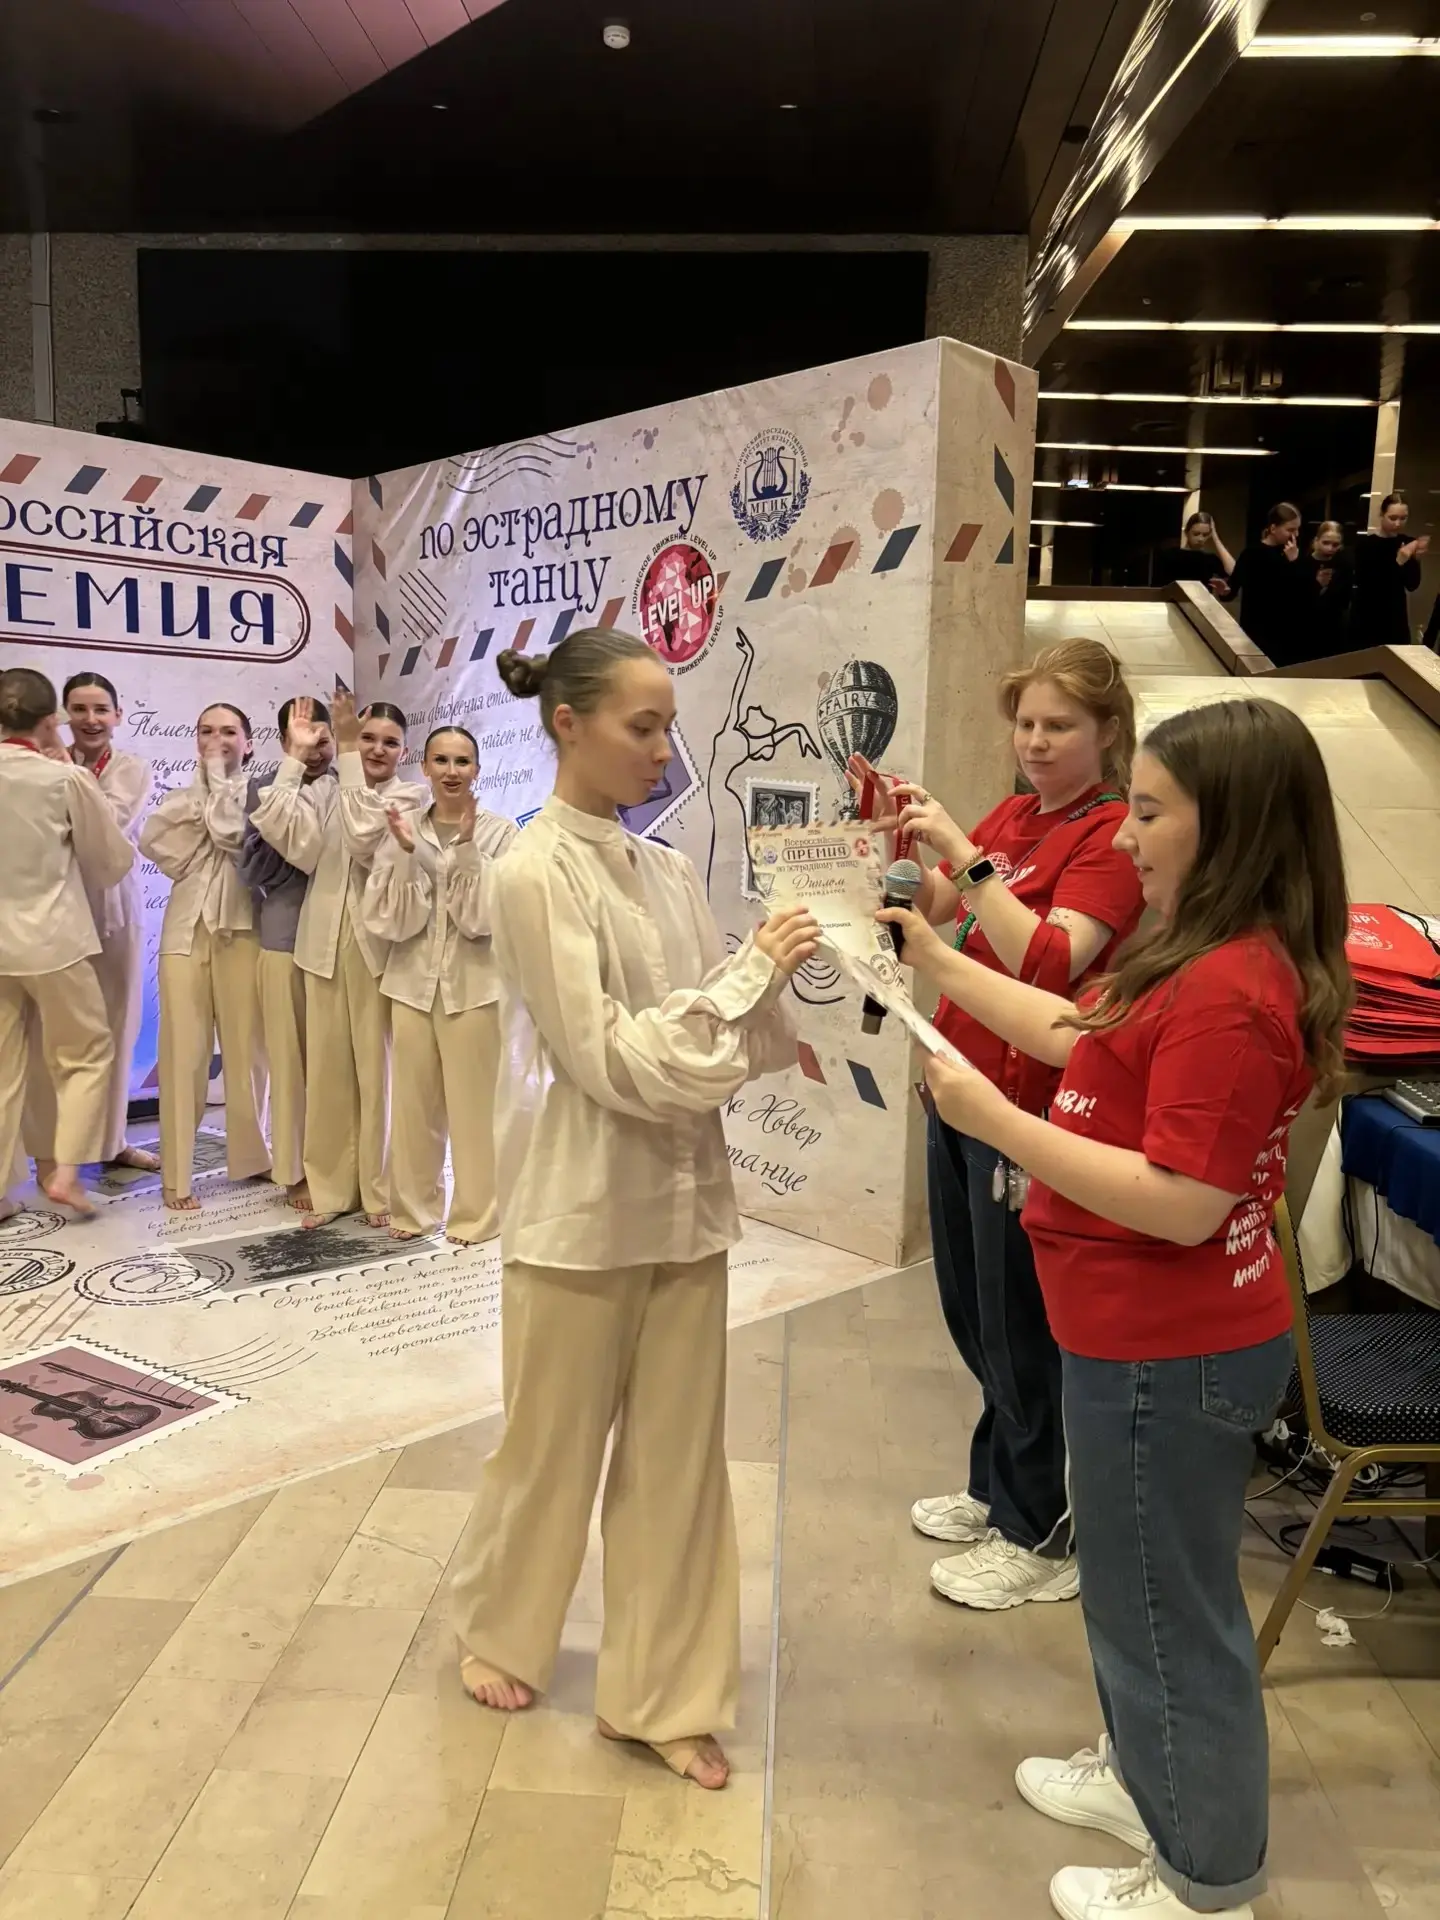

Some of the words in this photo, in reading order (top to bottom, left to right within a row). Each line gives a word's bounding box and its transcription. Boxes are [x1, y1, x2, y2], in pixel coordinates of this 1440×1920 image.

[743, 436, 770, 465] ИНСТИТУТ
[771, 436, 799, 456] КУЛЬТУРЫ
[419, 521, 455, 560] по
[463, 474, 709, 559] эстрадному
[750, 498, 788, 514] МГИК
[488, 556, 612, 613] танцу
[631, 554, 652, 616] ТВОРЧЕСКОЕ
[651, 533, 688, 557] ДВИЖЕНИЕ
[690, 533, 709, 554] LEVEL
[708, 549, 717, 562] UP
[5, 562, 275, 645] ЕМИЯ
[639, 590, 689, 636] LEVEL
[676, 647, 710, 677] ДВИЖЕНИЕ
[708, 620, 723, 648] LEVEL
[717, 604, 725, 619] UP
[428, 691, 484, 734] движения
[825, 691, 872, 716] FAIRY
[481, 728, 516, 751] ничего
[519, 724, 533, 743] не
[787, 846, 847, 860] ПРЕМИЯ
[787, 861, 834, 873] эстрадному
[792, 873, 845, 889] Диплом
[748, 1094, 822, 1150] Новер
[726, 1144, 808, 1196] танце
[273, 1293, 324, 1309] Одно
[365, 1277, 406, 1291] один
[313, 1287, 412, 1313] высказать
[451, 1274, 479, 1283] что
[334, 1295, 428, 1321] никакими
[360, 1312, 480, 1344] человеческого
[367, 1322, 499, 1357] недостаточно
